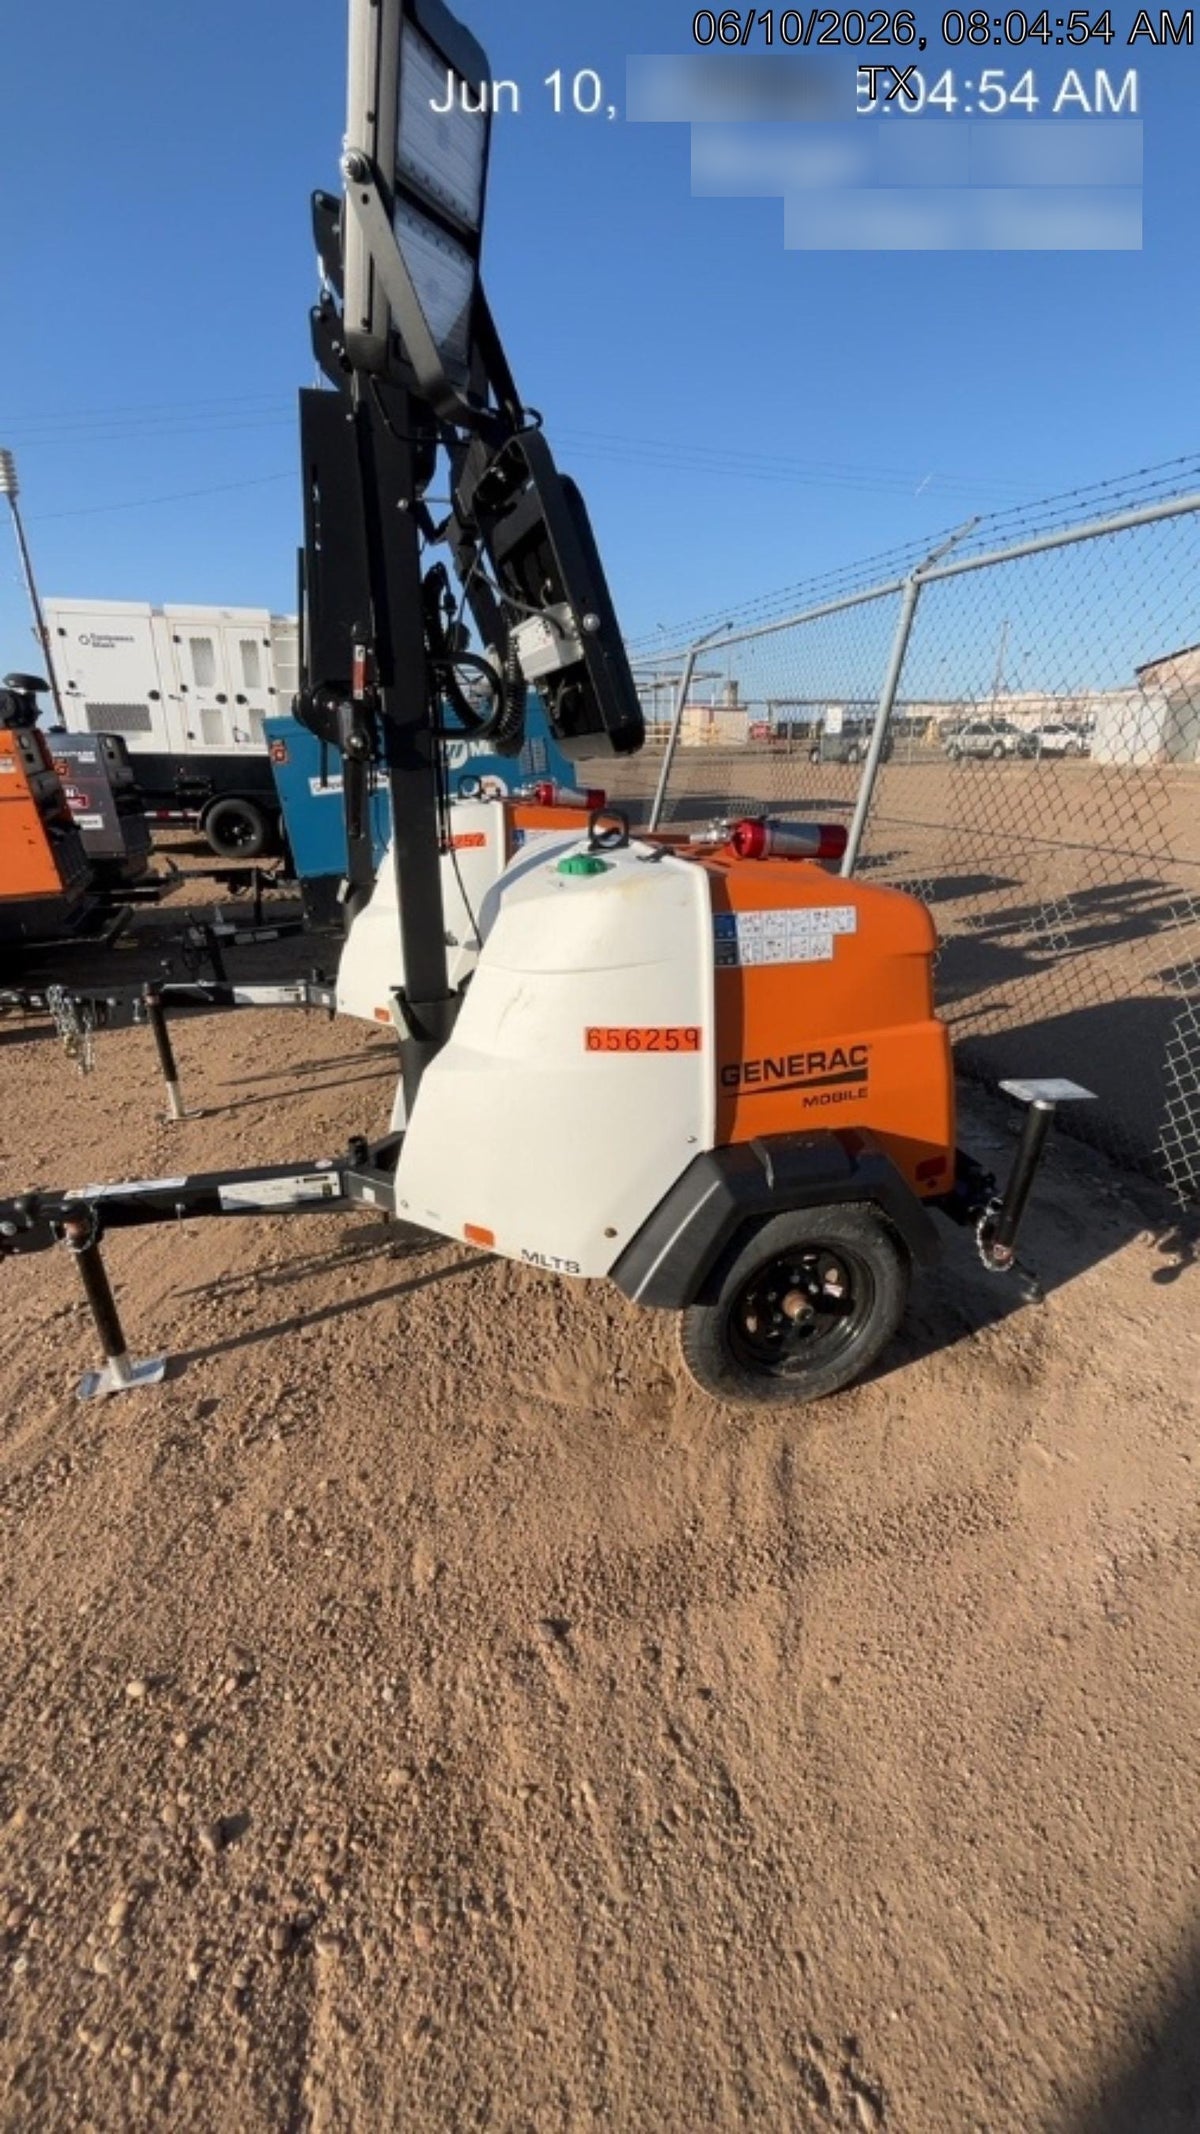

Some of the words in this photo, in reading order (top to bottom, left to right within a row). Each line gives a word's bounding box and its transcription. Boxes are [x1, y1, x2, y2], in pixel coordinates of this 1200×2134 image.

[586, 1027, 699, 1051] 656259
[720, 1044, 869, 1087] GENERAC
[802, 1087, 868, 1108] MOBILE
